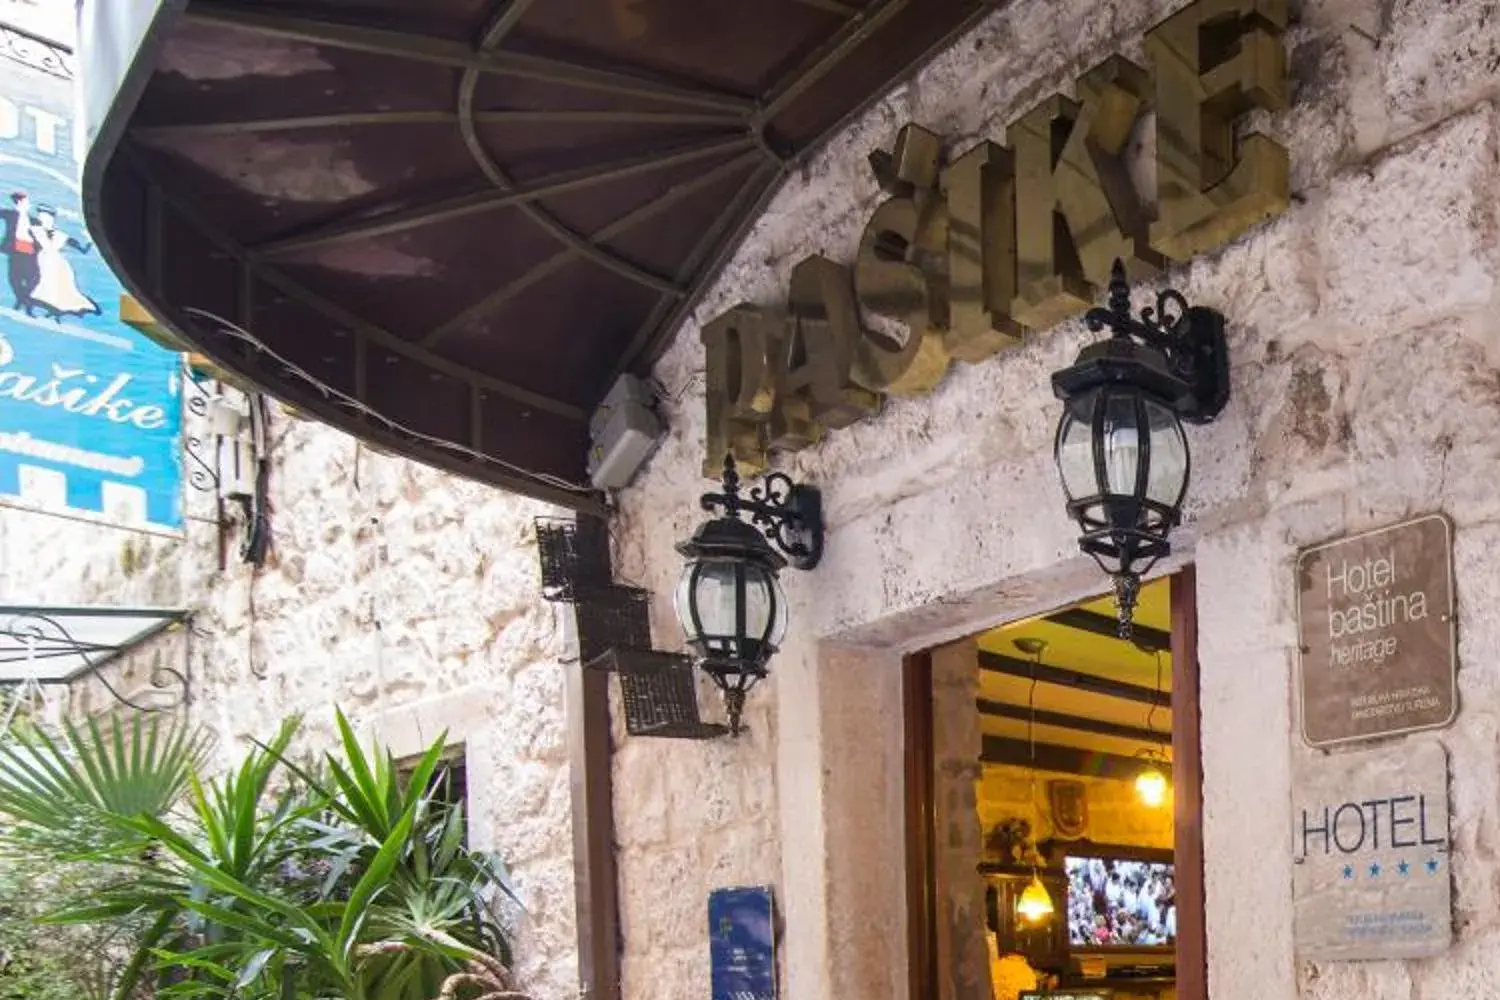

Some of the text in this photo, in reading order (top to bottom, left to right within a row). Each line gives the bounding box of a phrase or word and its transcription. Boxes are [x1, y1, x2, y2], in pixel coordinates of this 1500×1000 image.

[700, 0, 1290, 478] PAŠIKE
[1326, 549, 1396, 599] Hotel
[1330, 636, 1398, 666] heritage
[1302, 794, 1445, 857] HOTEL
